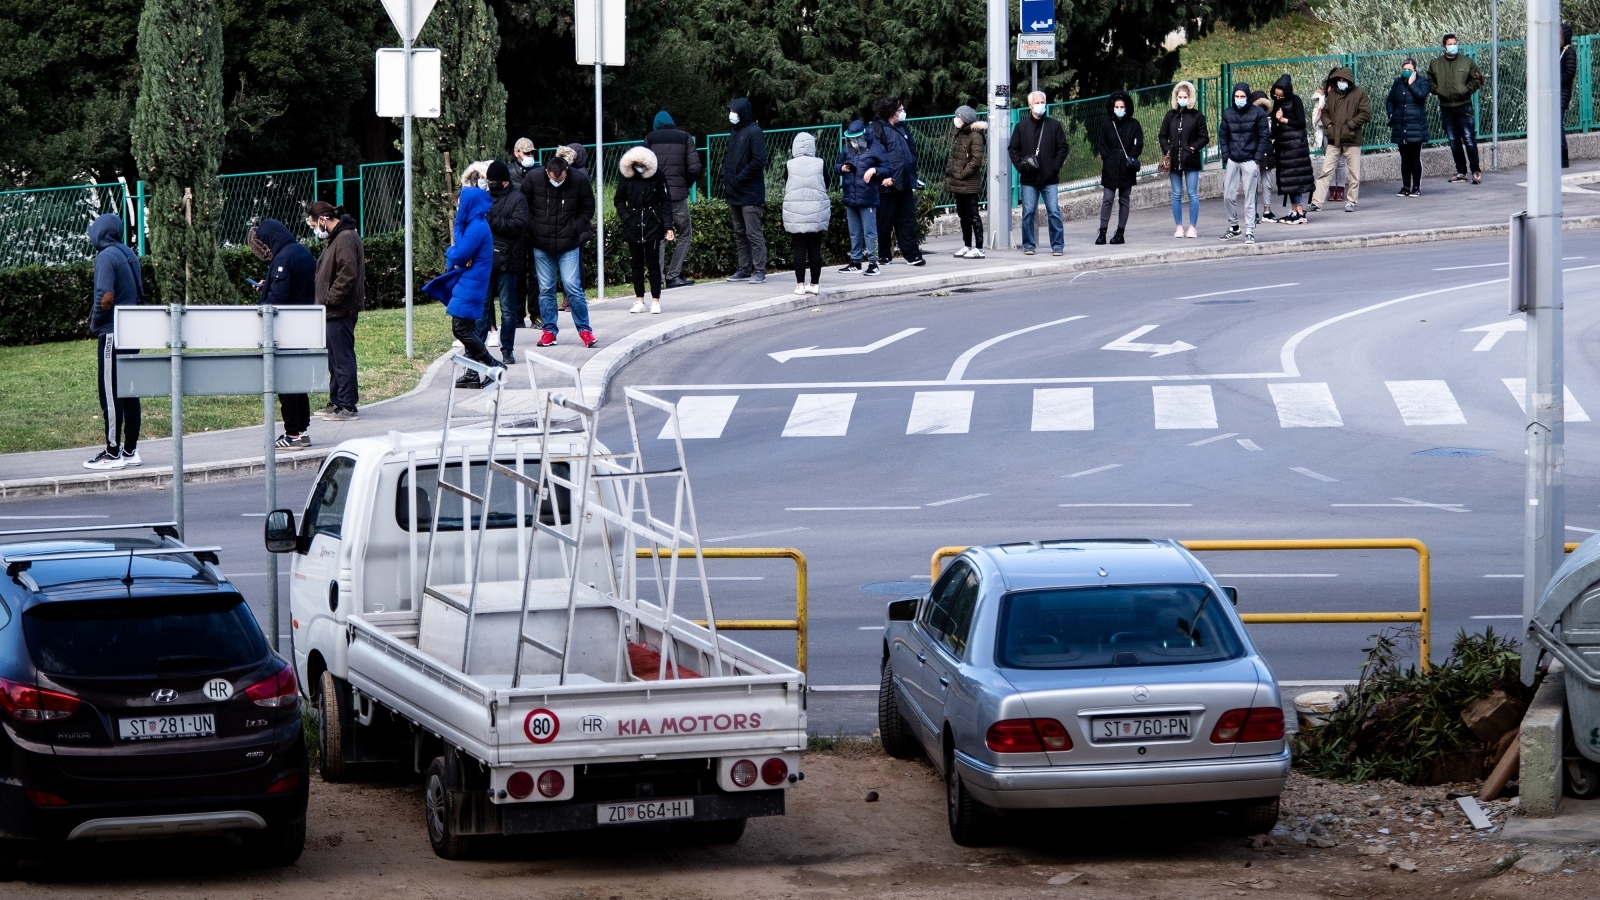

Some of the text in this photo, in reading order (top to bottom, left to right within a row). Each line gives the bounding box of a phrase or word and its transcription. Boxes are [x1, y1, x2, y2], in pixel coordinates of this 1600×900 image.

[209, 681, 229, 698] HR
[130, 719, 147, 736] ST
[159, 715, 213, 734] 281-UN
[532, 717, 550, 736] 80
[582, 718, 603, 732] HR
[618, 712, 762, 736] KIA MOTORS
[1104, 718, 1188, 737] ST 760-PN
[608, 800, 688, 822] ZD 664-HI
